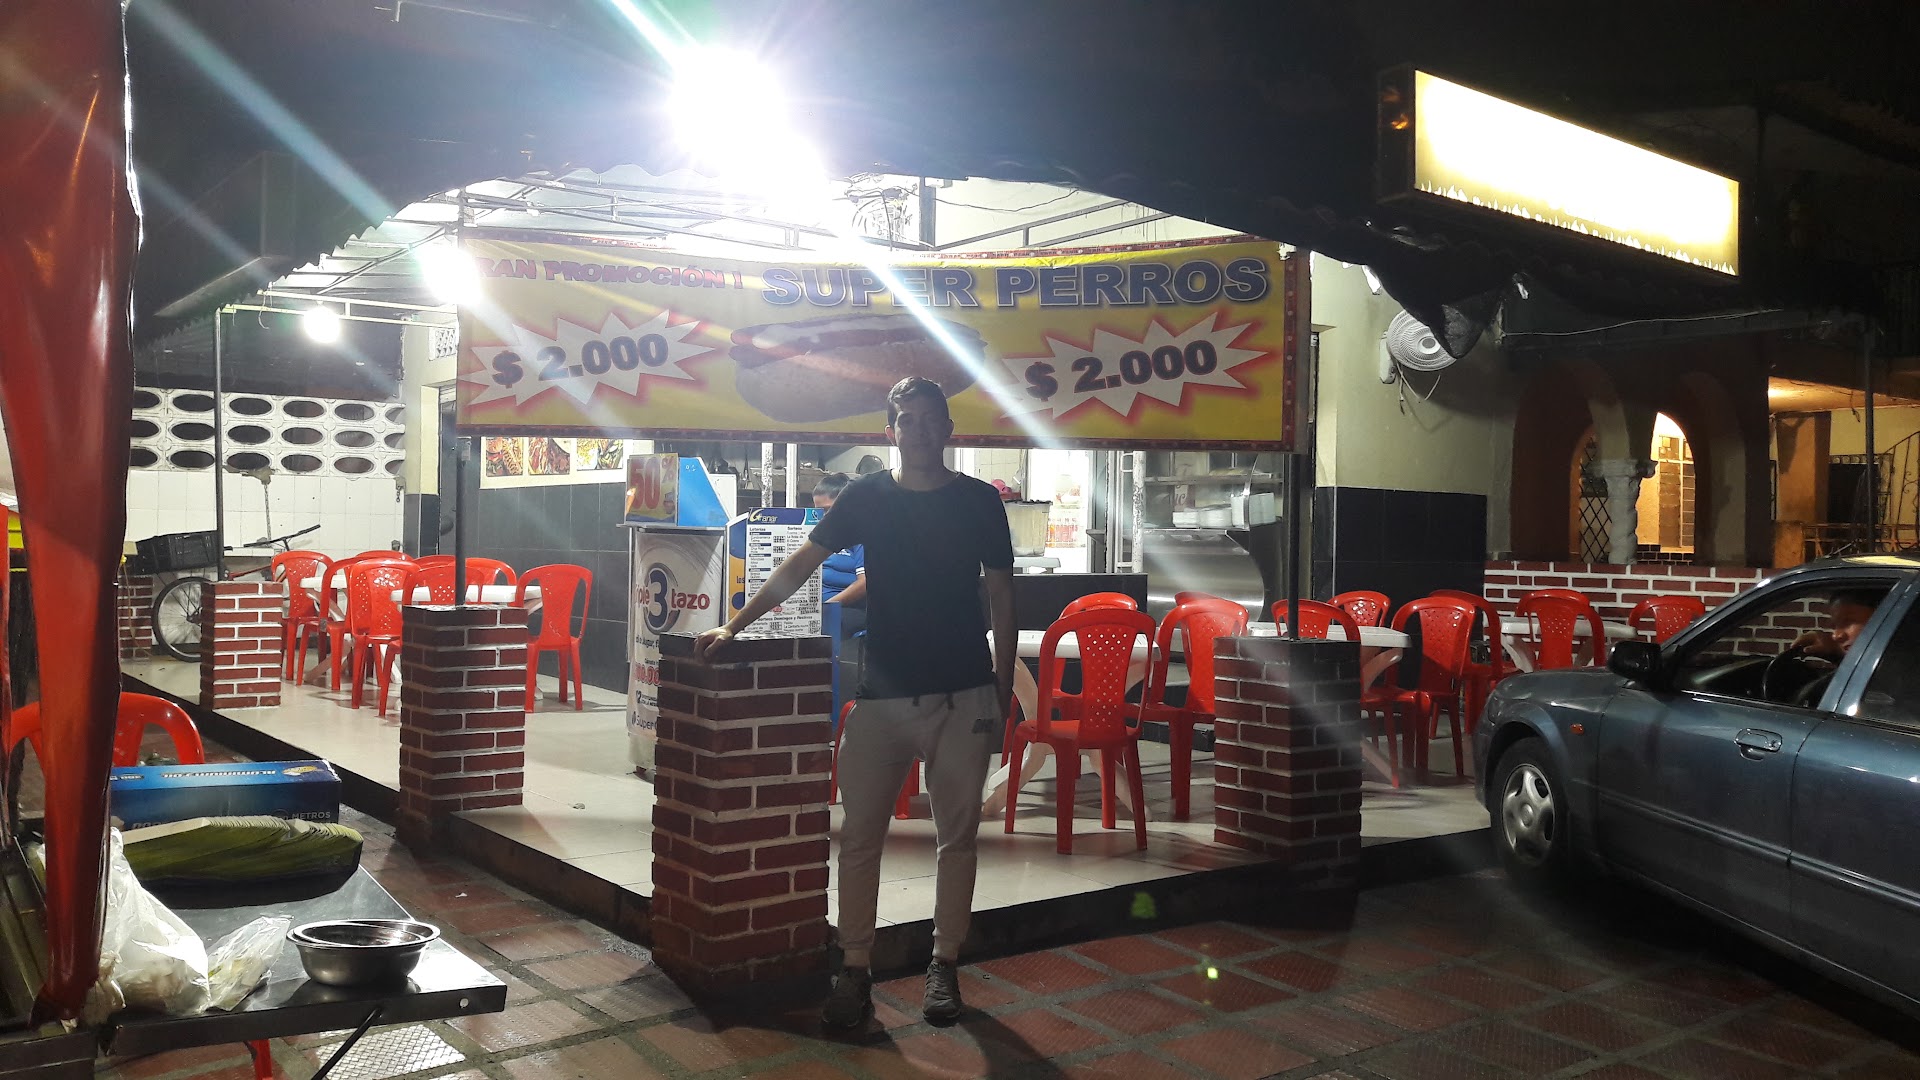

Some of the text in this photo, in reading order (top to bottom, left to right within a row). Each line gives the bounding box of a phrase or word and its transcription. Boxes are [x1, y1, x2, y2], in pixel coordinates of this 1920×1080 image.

[476, 257, 537, 279] RAN
[542, 260, 725, 288] PROMOCIÓN
[761, 258, 1270, 307] SUPER PERROS
[491, 333, 669, 388] $ 2.000
[1025, 339, 1218, 402] $ 2.000
[648, 569, 668, 627] 3
[671, 588, 710, 610] tazo
[292, 811, 331, 820] METROS
